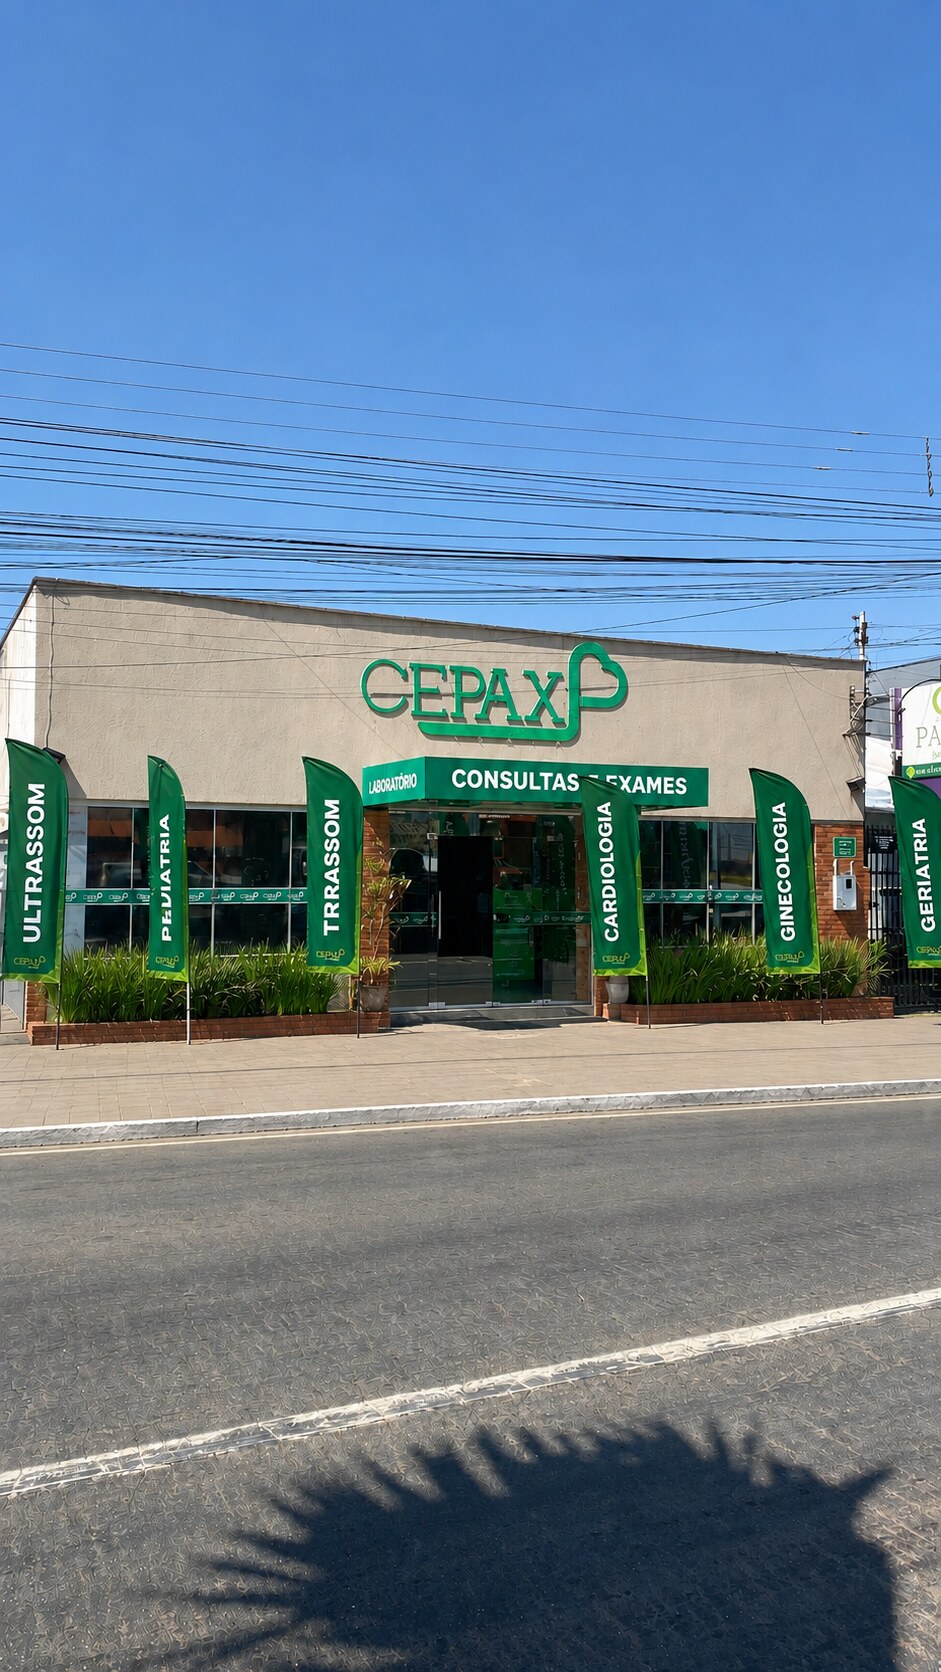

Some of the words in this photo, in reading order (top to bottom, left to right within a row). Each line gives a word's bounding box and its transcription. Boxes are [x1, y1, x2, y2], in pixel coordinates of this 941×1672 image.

[368, 772, 417, 795] LABORATÓRIO
[451, 768, 580, 792] CONSULTAS
[22, 783, 45, 943] ULTRASSOM
[323, 799, 340, 936] TRRASSOM
[596, 801, 620, 943] CARDIOLOGIA
[771, 802, 796, 942] GINECOLOGIA
[911, 818, 936, 932] GERIATRIA
